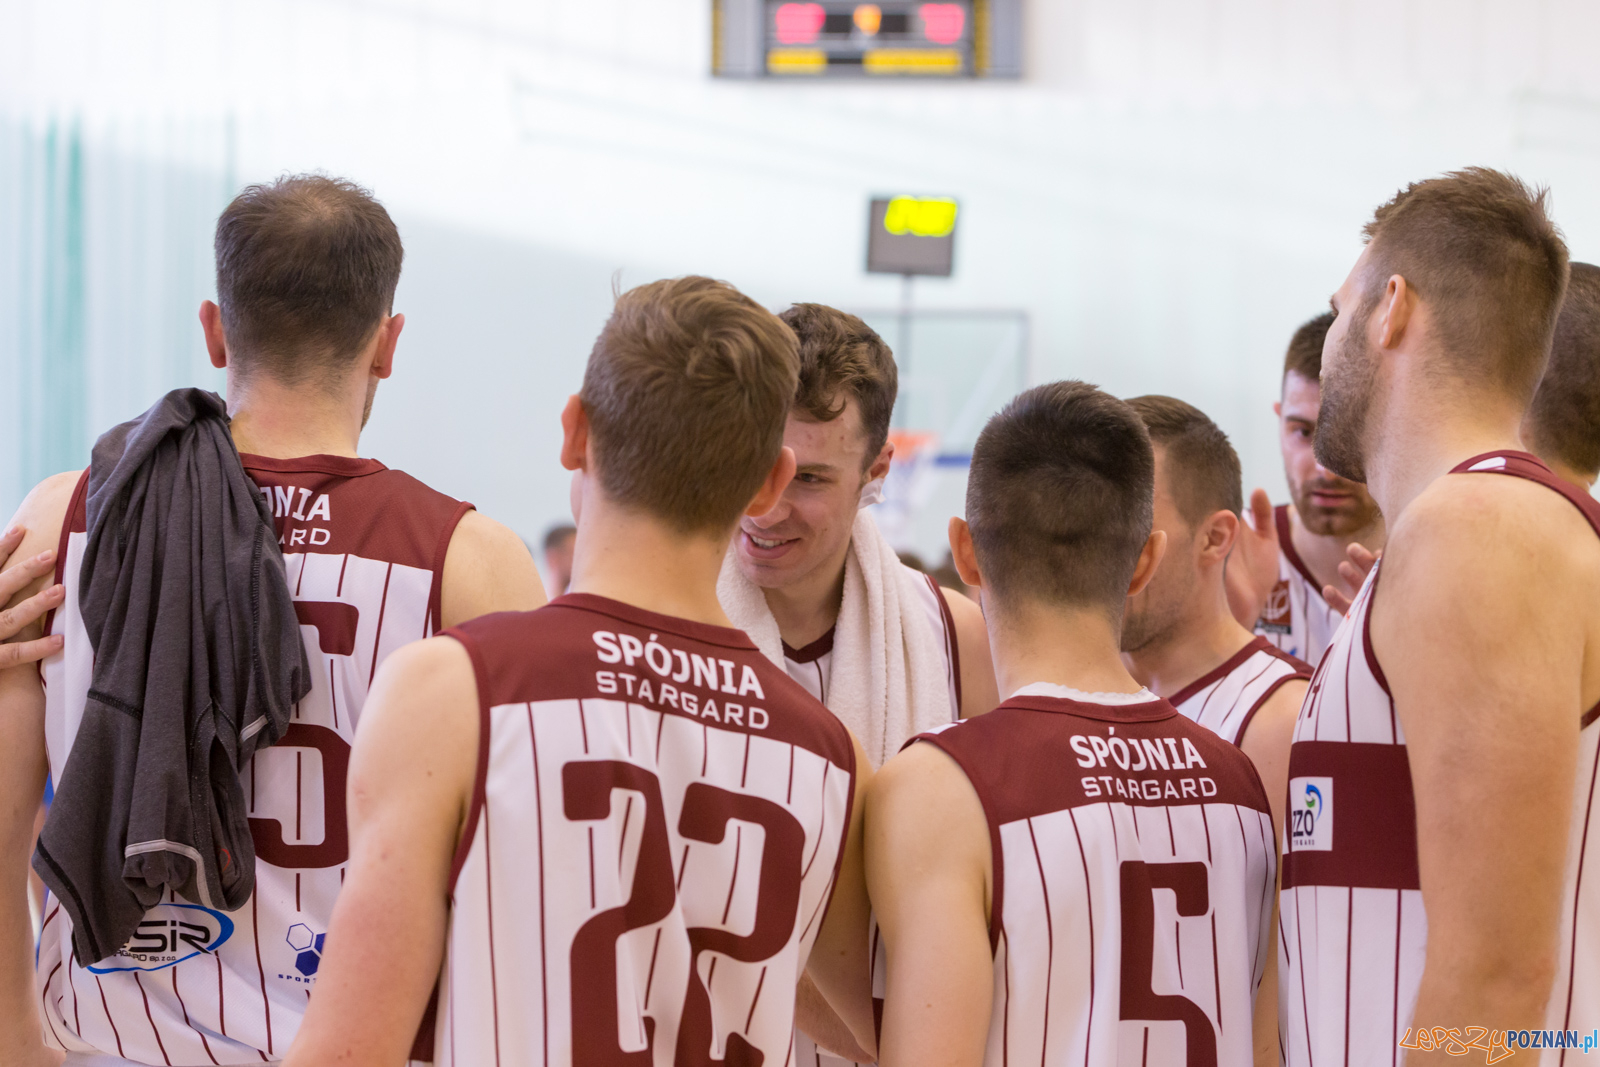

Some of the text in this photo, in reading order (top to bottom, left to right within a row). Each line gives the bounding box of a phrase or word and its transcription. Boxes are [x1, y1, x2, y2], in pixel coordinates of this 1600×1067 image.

[592, 630, 766, 700] SPÓJNIA
[595, 670, 770, 730] STARGARD
[1069, 726, 1208, 772] SPÓJNIA
[1080, 775, 1218, 801] STARGARD
[562, 760, 806, 1067] 22
[1119, 860, 1217, 1067] 5
